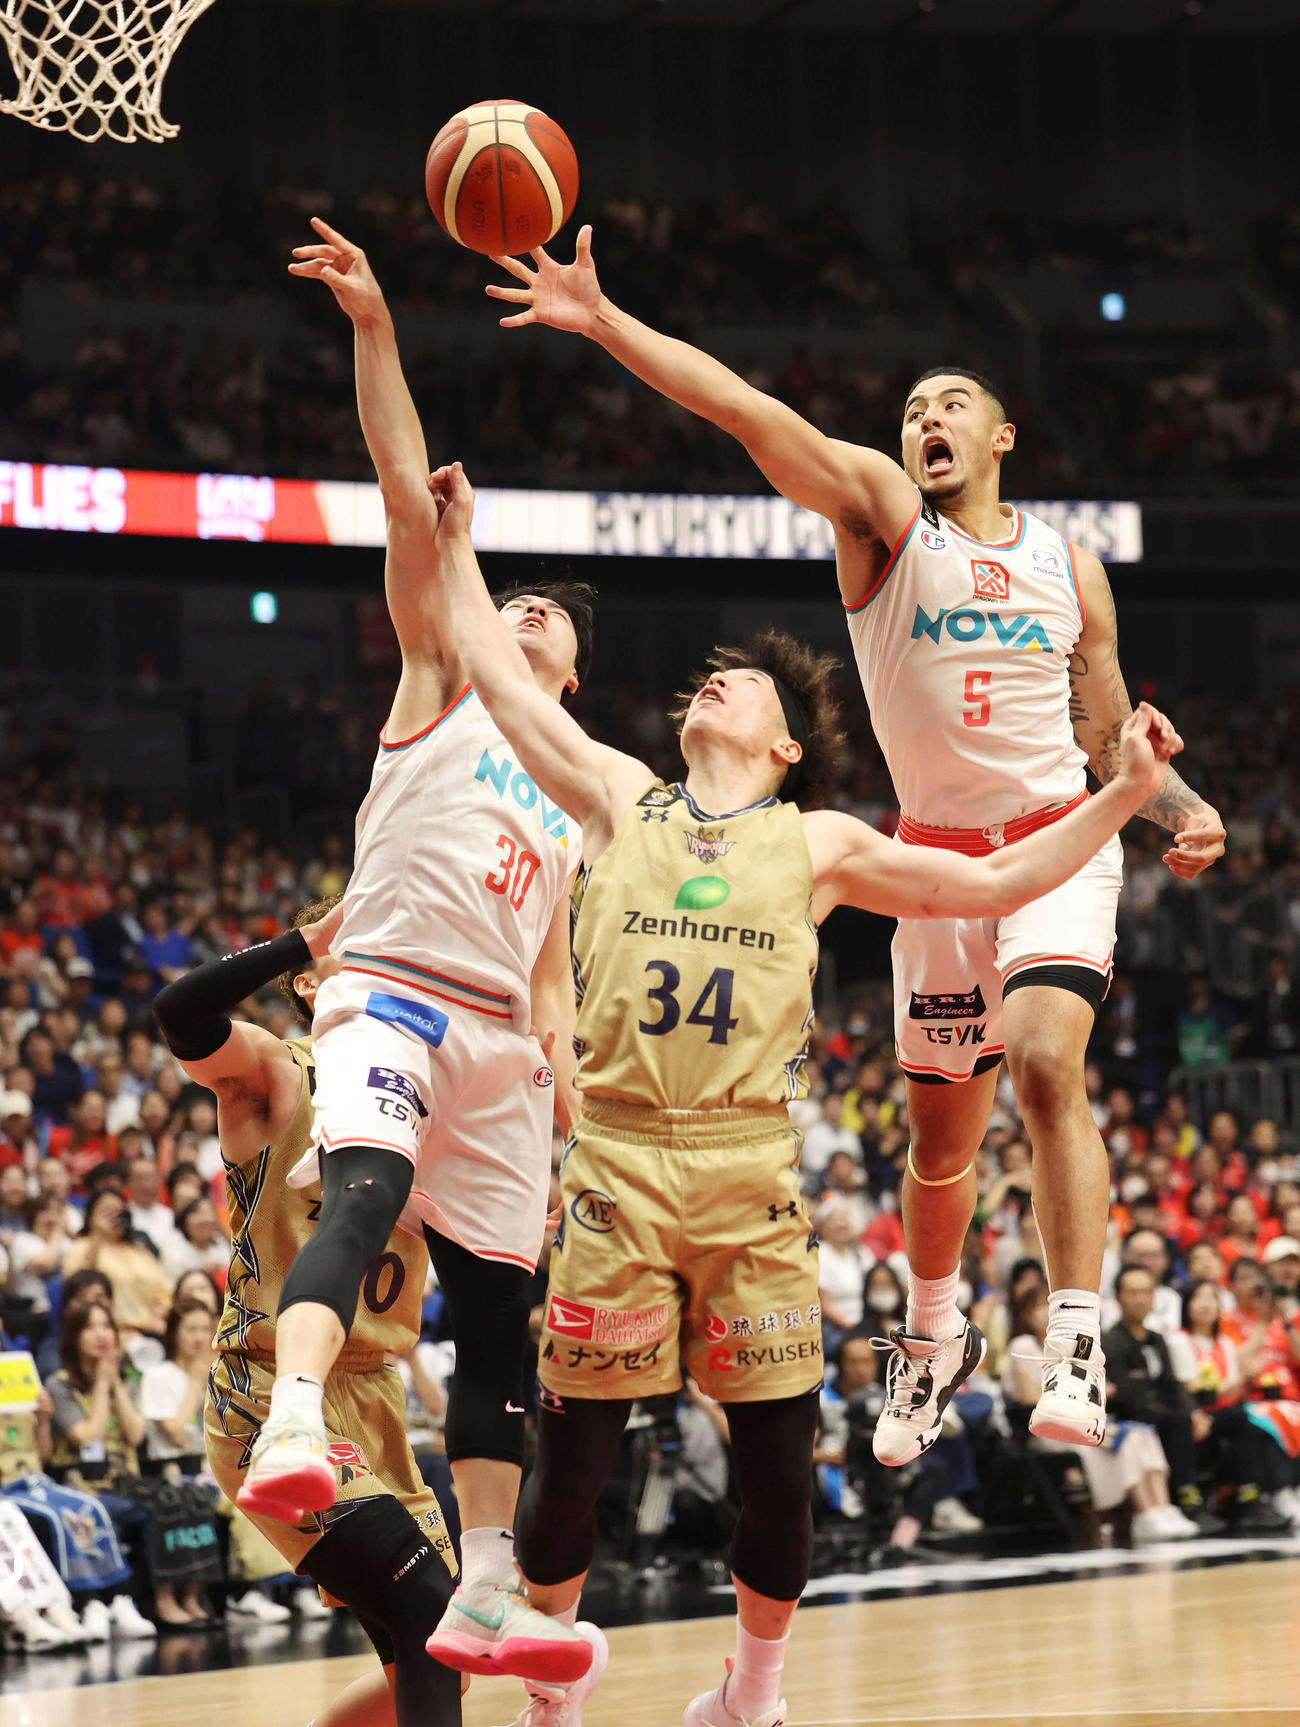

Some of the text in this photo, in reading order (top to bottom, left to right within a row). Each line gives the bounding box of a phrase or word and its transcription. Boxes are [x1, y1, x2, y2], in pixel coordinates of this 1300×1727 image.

[910, 603, 1053, 654] NOVA
[963, 670, 992, 728] 5
[485, 833, 541, 912] 30
[622, 911, 776, 951] Zenhoren
[638, 960, 740, 1046] 34
[923, 1004, 975, 1017] Engineer
[597, 1304, 669, 1328] RYUKYU
[732, 1305, 820, 1337] 琉球銀行
[595, 1325, 669, 1344] DAIHATSU
[568, 1343, 661, 1371] ナンセイ
[736, 1340, 820, 1366] RYUSEK
